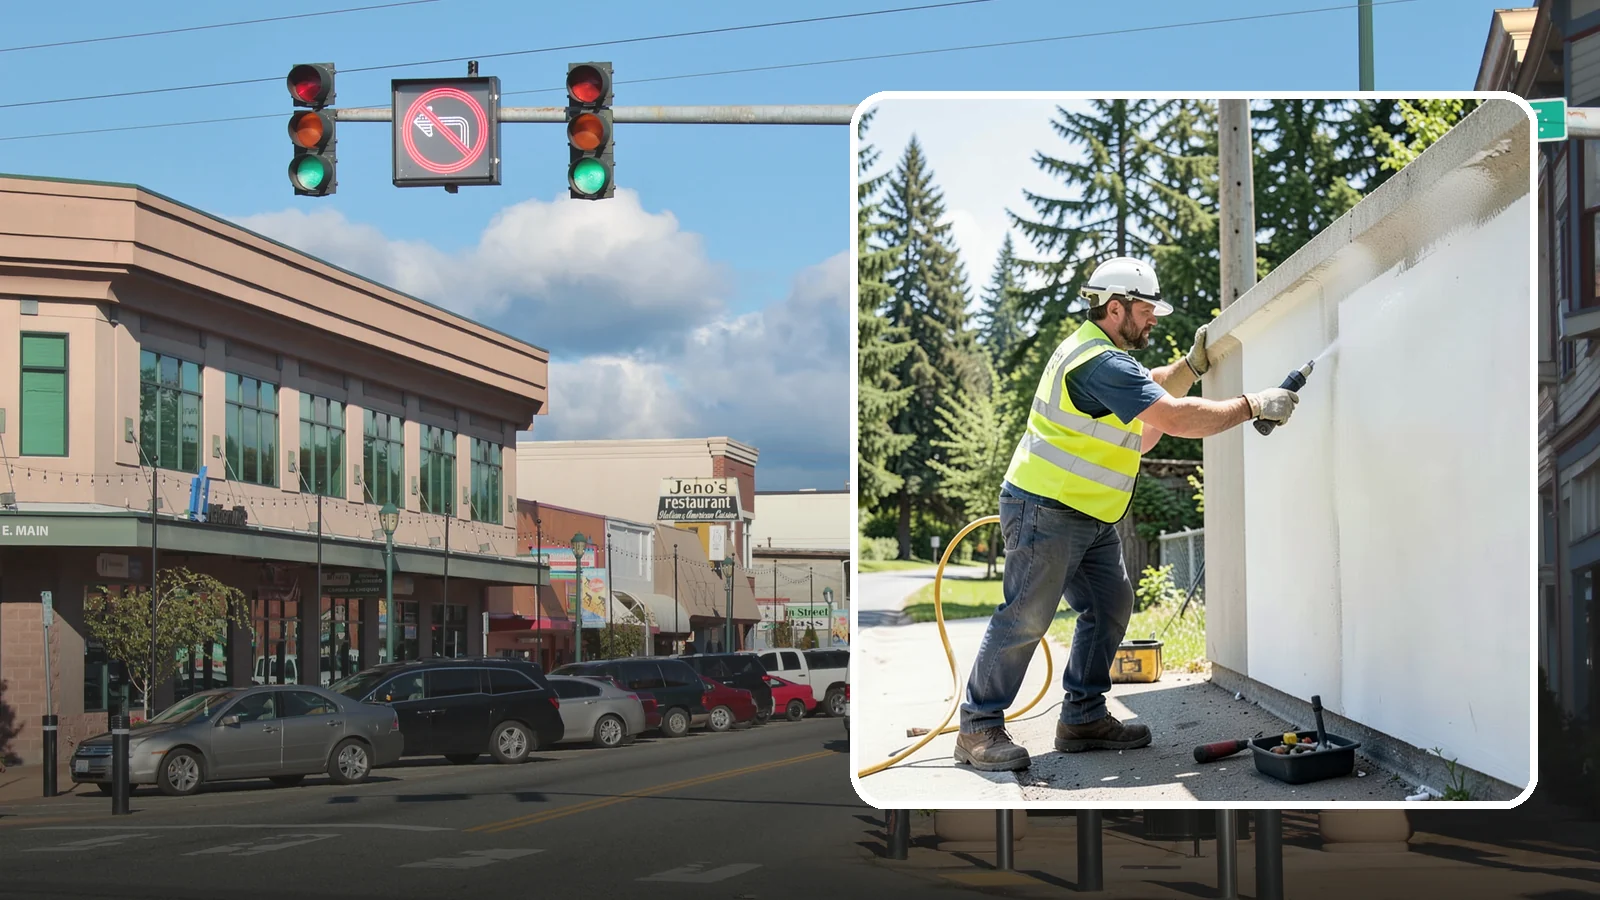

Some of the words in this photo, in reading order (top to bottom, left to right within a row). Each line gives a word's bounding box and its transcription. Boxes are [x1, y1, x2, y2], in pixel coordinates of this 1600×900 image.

[670, 480, 727, 495] Jeno's
[665, 497, 731, 509] restaurant
[658, 509, 682, 520] Italian
[686, 509, 714, 520] American
[714, 509, 738, 519] Cuisine
[2, 525, 13, 536] E.
[15, 525, 49, 536] MAIN
[797, 607, 828, 617] Street
